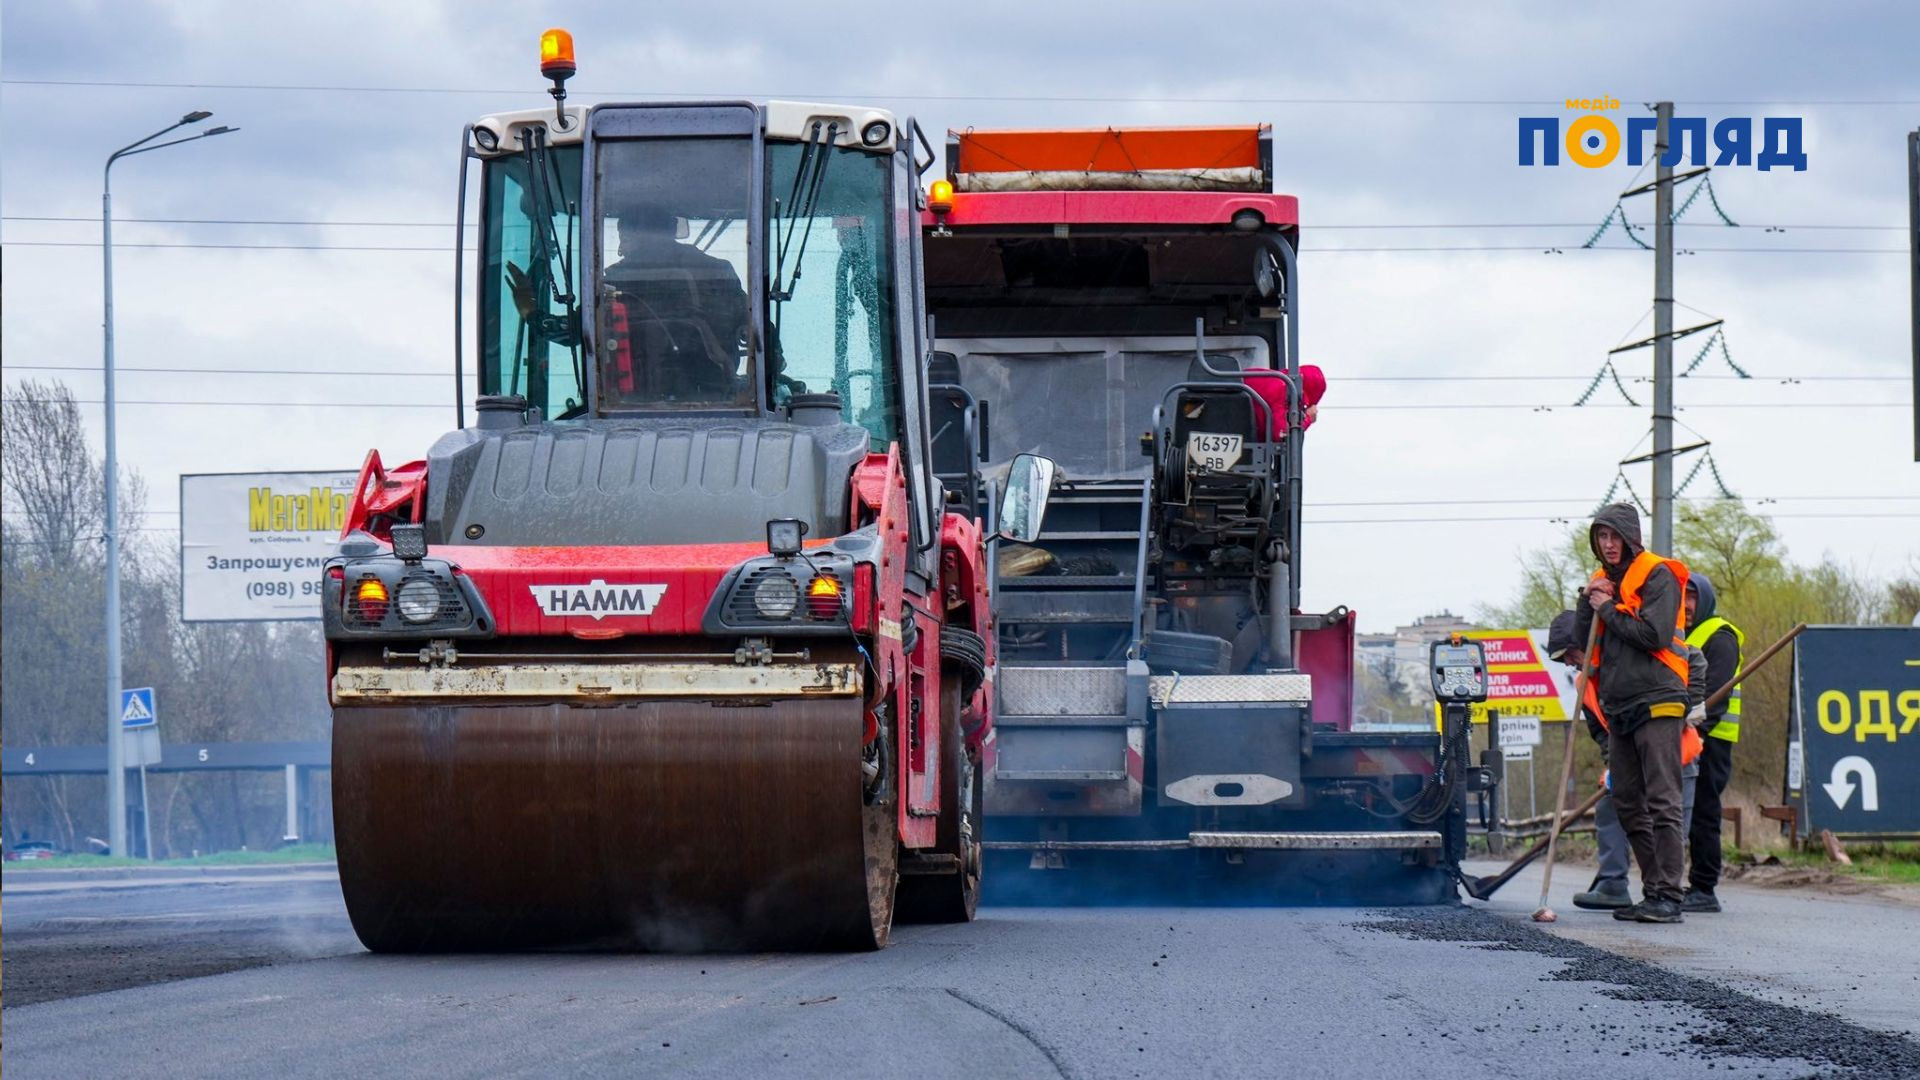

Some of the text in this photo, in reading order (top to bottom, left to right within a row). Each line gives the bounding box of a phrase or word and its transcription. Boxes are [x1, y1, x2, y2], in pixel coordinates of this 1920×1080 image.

[1194, 436, 1239, 452] 16397
[246, 582, 294, 600] (098)
[550, 589, 645, 611] HAMM
[1817, 690, 1920, 742] ОДЯ
[25, 749, 208, 766] 4 5
